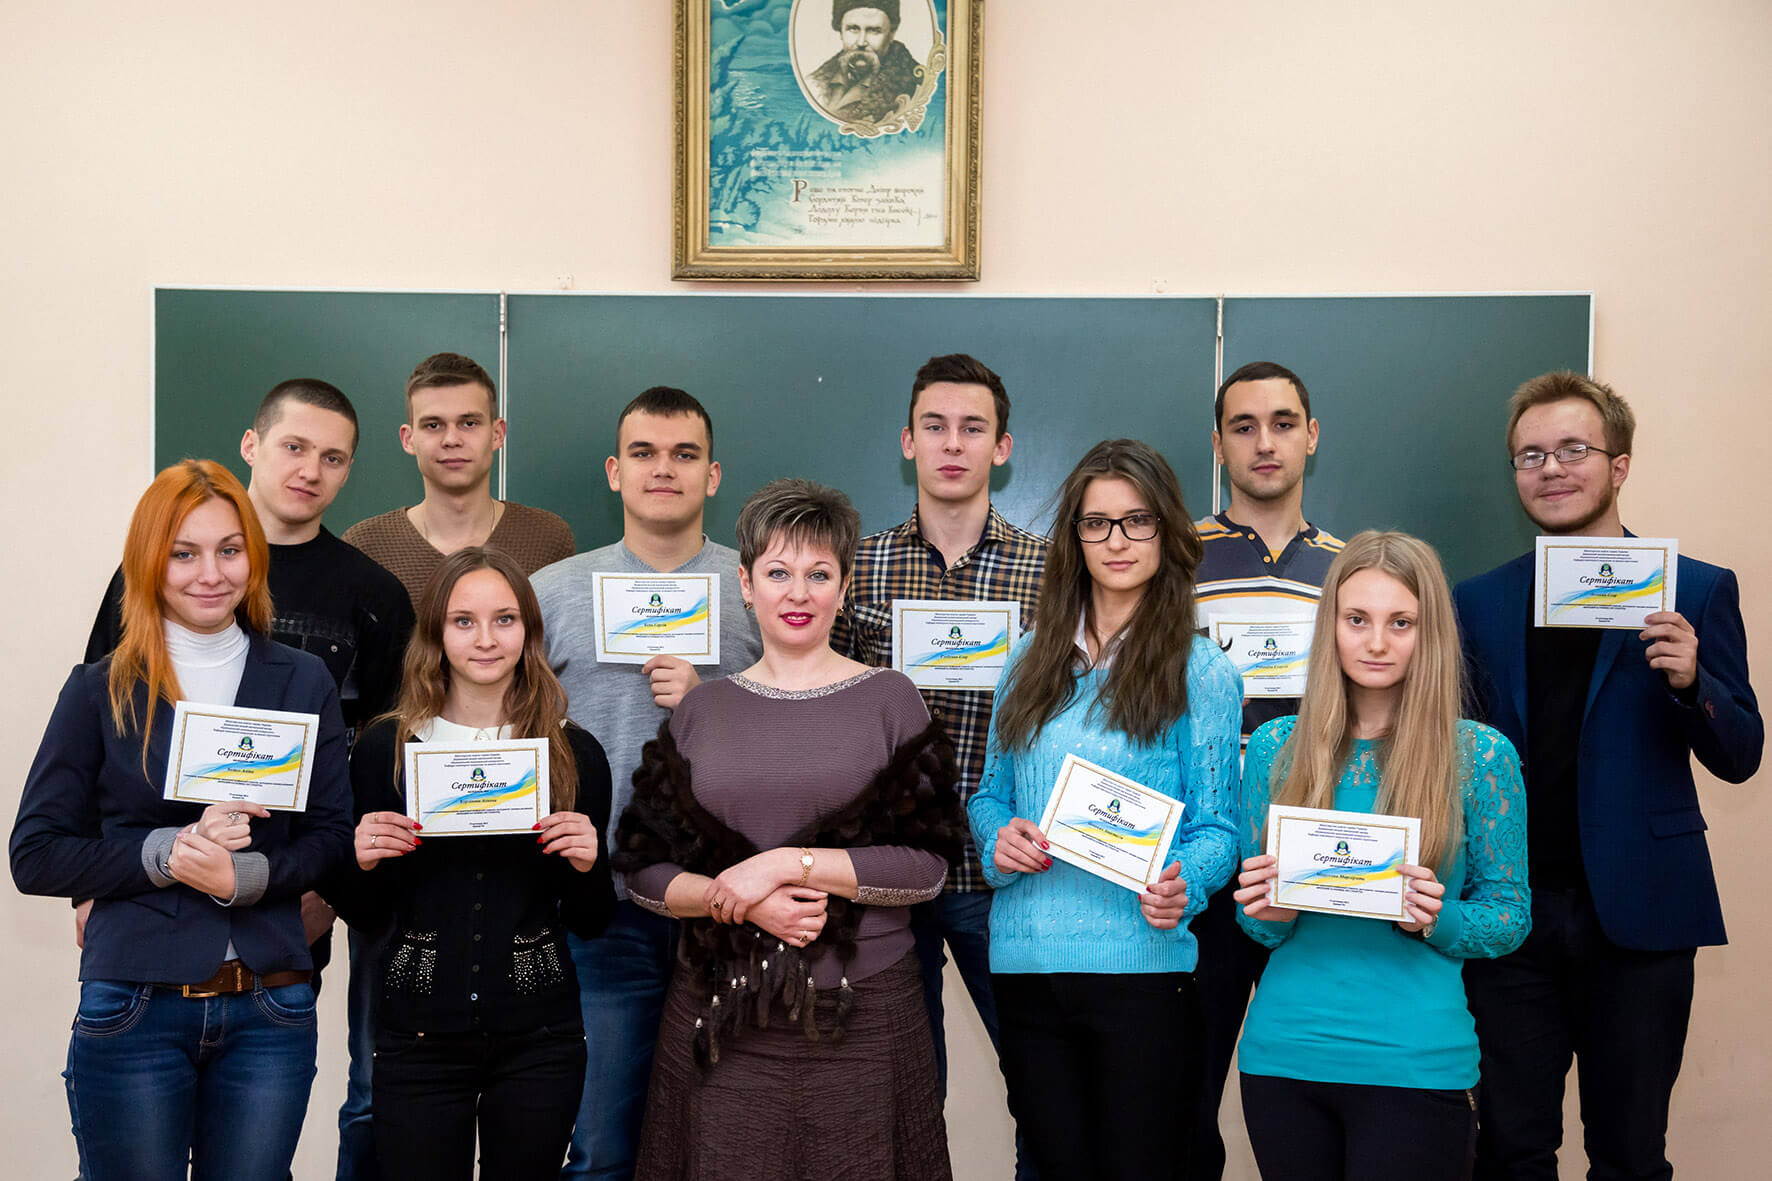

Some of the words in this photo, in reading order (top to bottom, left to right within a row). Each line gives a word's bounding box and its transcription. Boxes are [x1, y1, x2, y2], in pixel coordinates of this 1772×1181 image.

[1579, 575, 1634, 586] Сертифікат
[631, 605, 682, 615] Сертифікат
[931, 638, 982, 648] Сертифікат
[1247, 648, 1297, 659] Сертифікат
[217, 747, 274, 761] Сертифікат
[451, 781, 507, 792] Сертифікат
[1088, 803, 1136, 830] Сертифікат
[1313, 853, 1373, 866] Сертифікат
